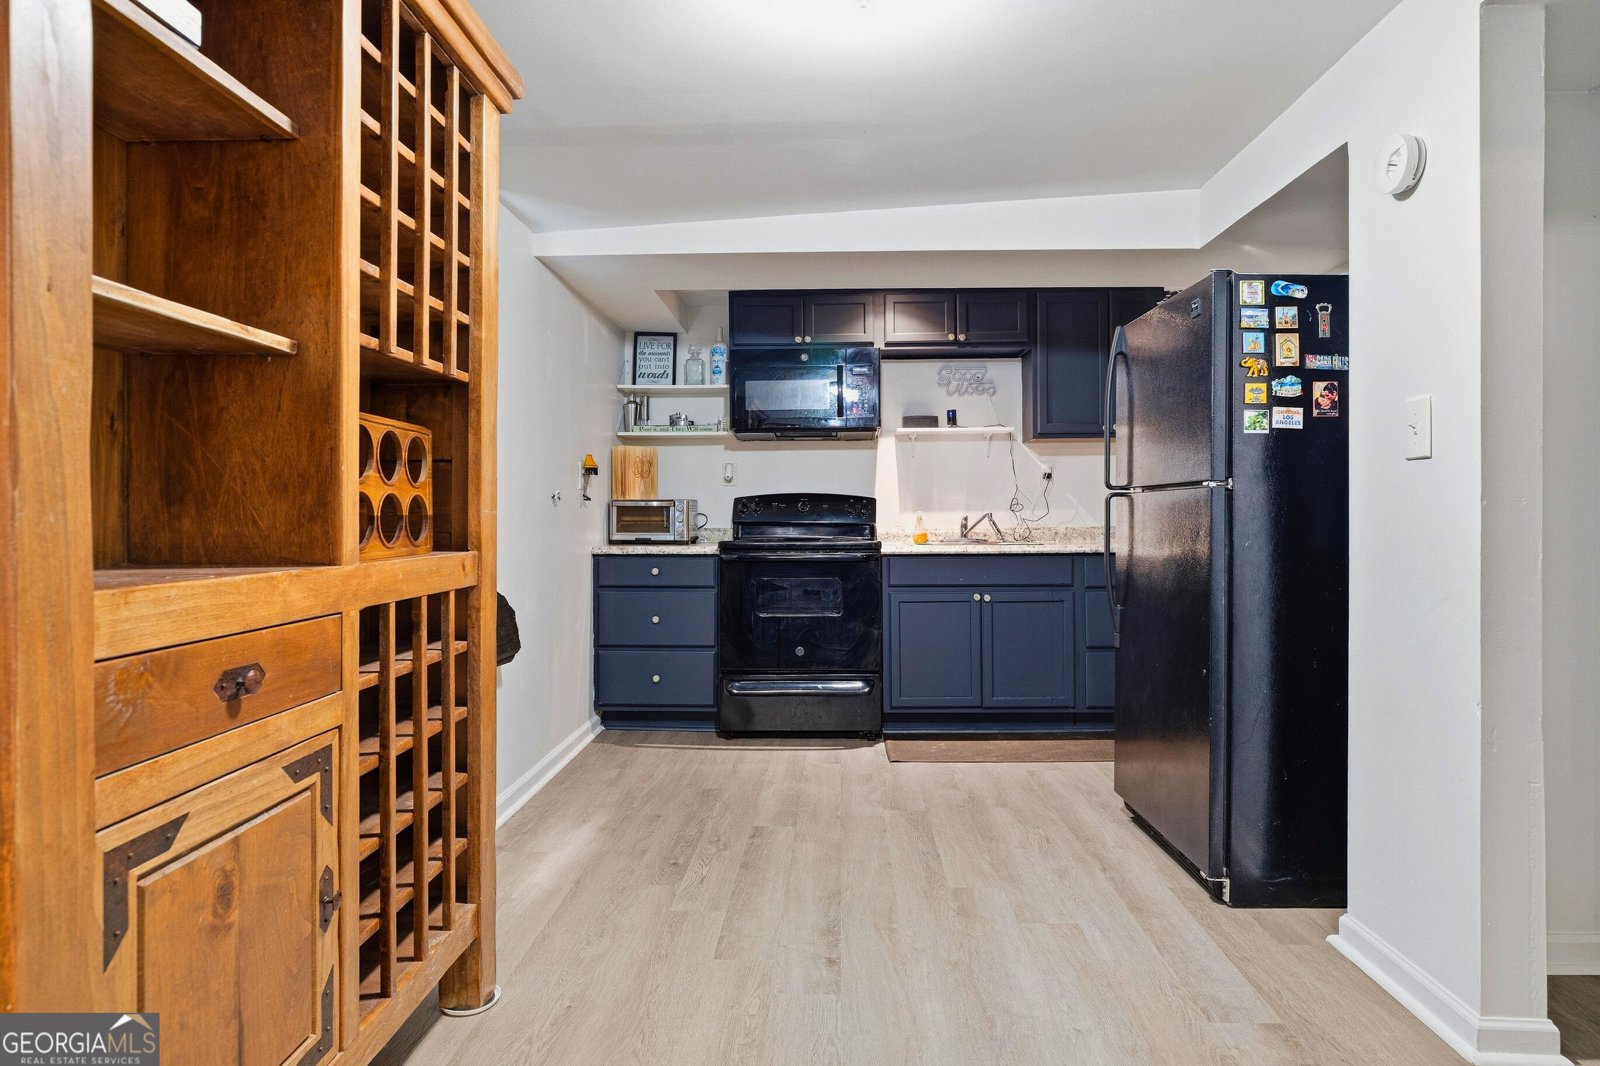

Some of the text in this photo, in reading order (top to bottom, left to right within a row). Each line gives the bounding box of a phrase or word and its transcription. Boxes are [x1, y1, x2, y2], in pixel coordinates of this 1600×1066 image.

[639, 341, 672, 350] LIVE FOR
[638, 370, 669, 379] words
